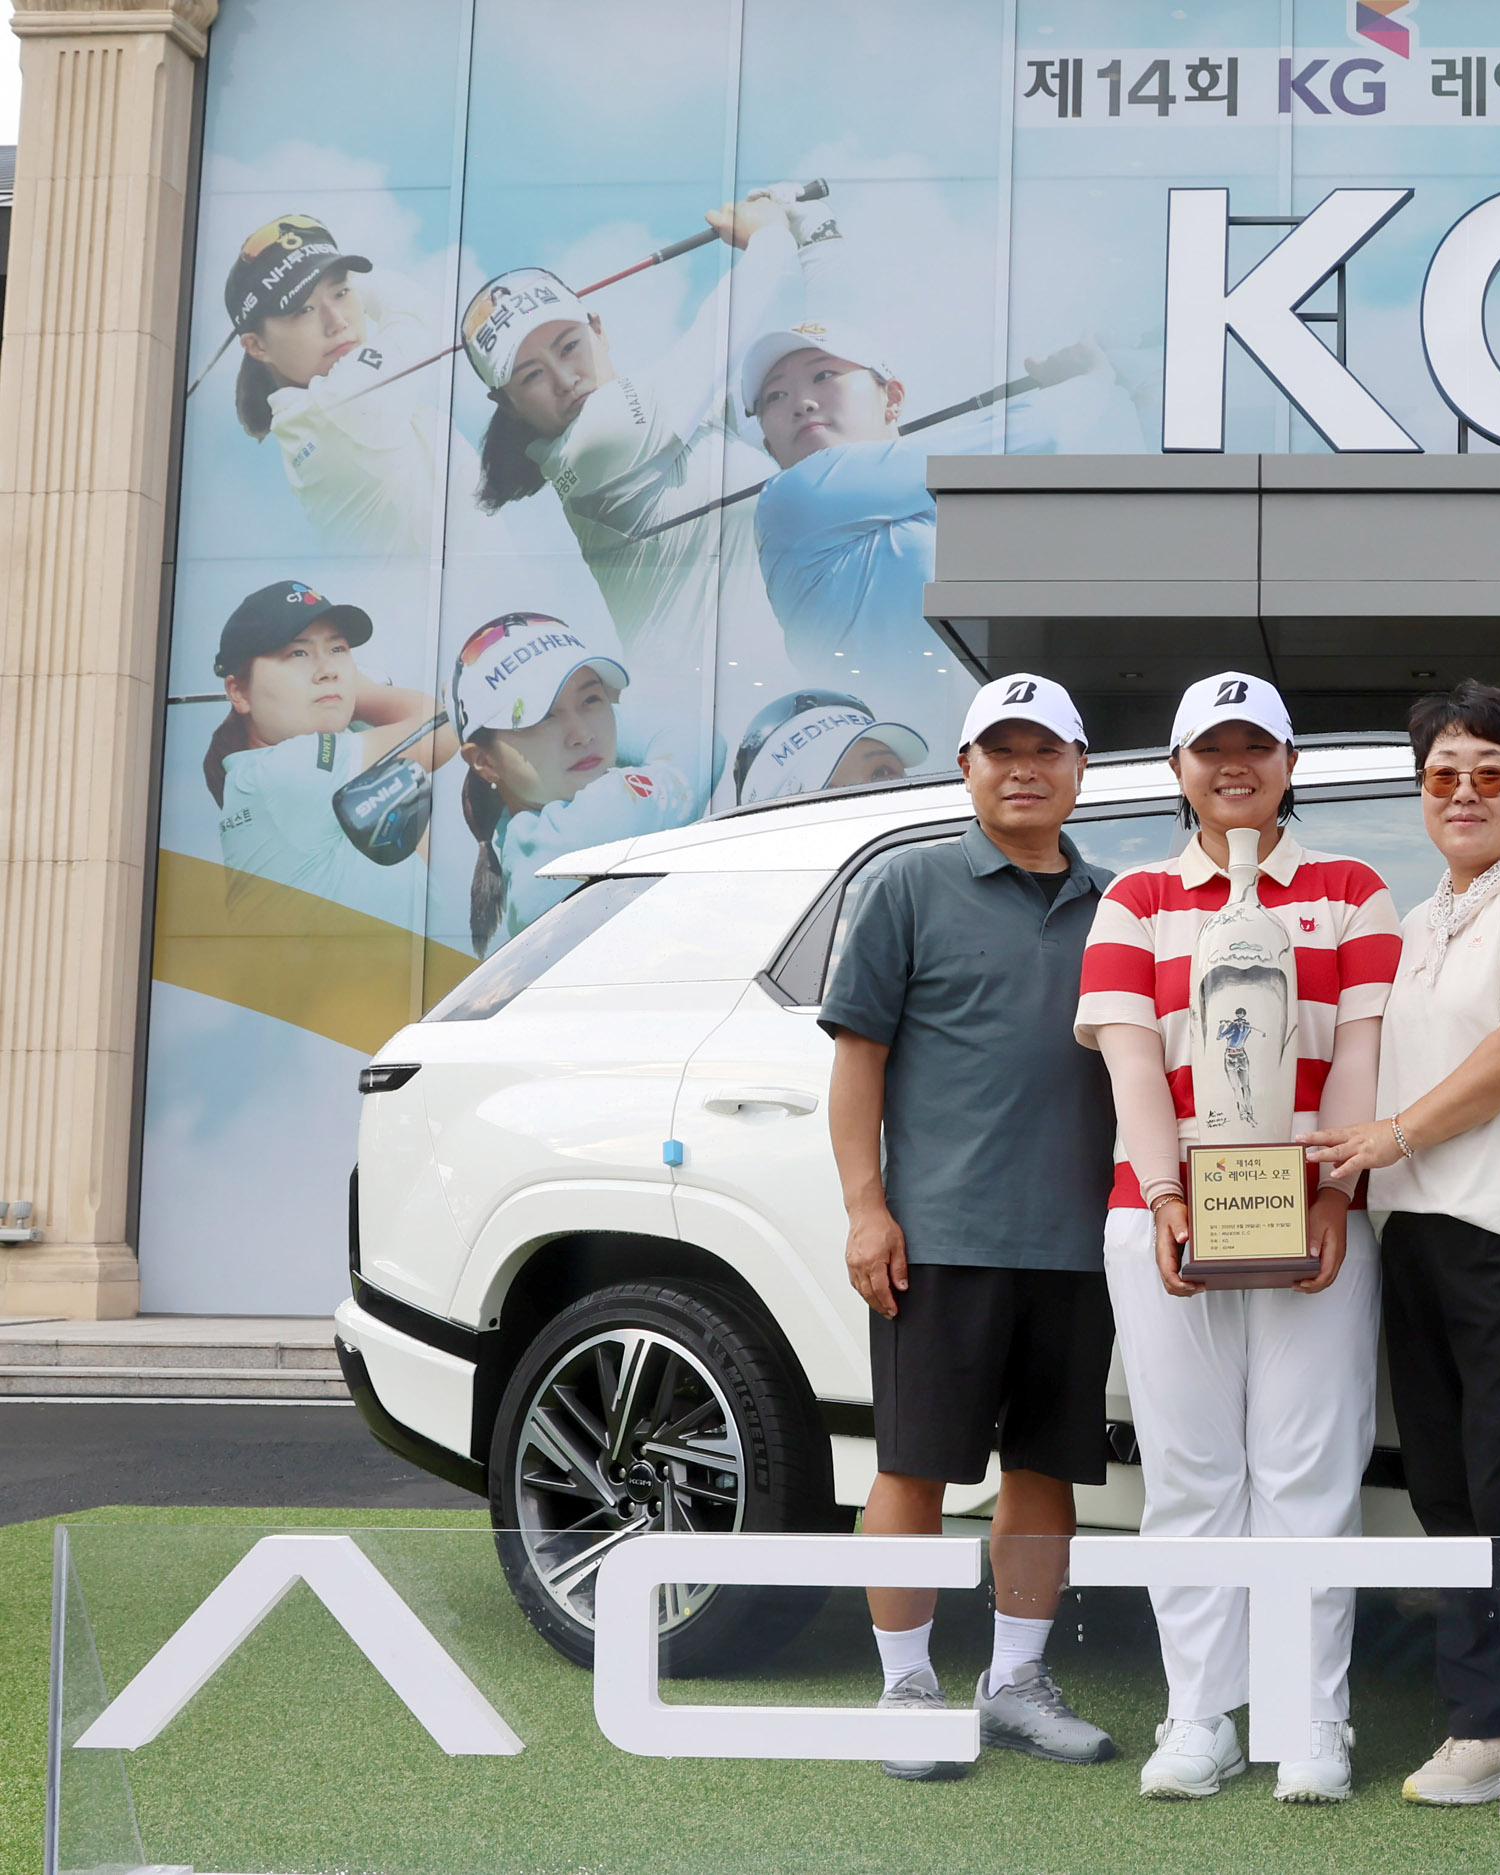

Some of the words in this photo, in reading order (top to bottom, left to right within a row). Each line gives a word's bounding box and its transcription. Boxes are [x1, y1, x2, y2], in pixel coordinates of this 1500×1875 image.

[1023, 57, 1239, 118] 제14회
[1278, 57, 1388, 116] KG
[475, 286, 561, 353] 동부건설
[354, 777, 404, 819] PING
[1204, 1172, 1223, 1182] KG
[1228, 1170, 1268, 1181] 레이디스
[1271, 1168, 1291, 1180] 오픈
[1236, 1159, 1261, 1168] 제14회
[1203, 1195, 1295, 1211] CHAMPION
[726, 1365, 770, 1488] MICHELIN
[628, 1478, 652, 1487] KGM
